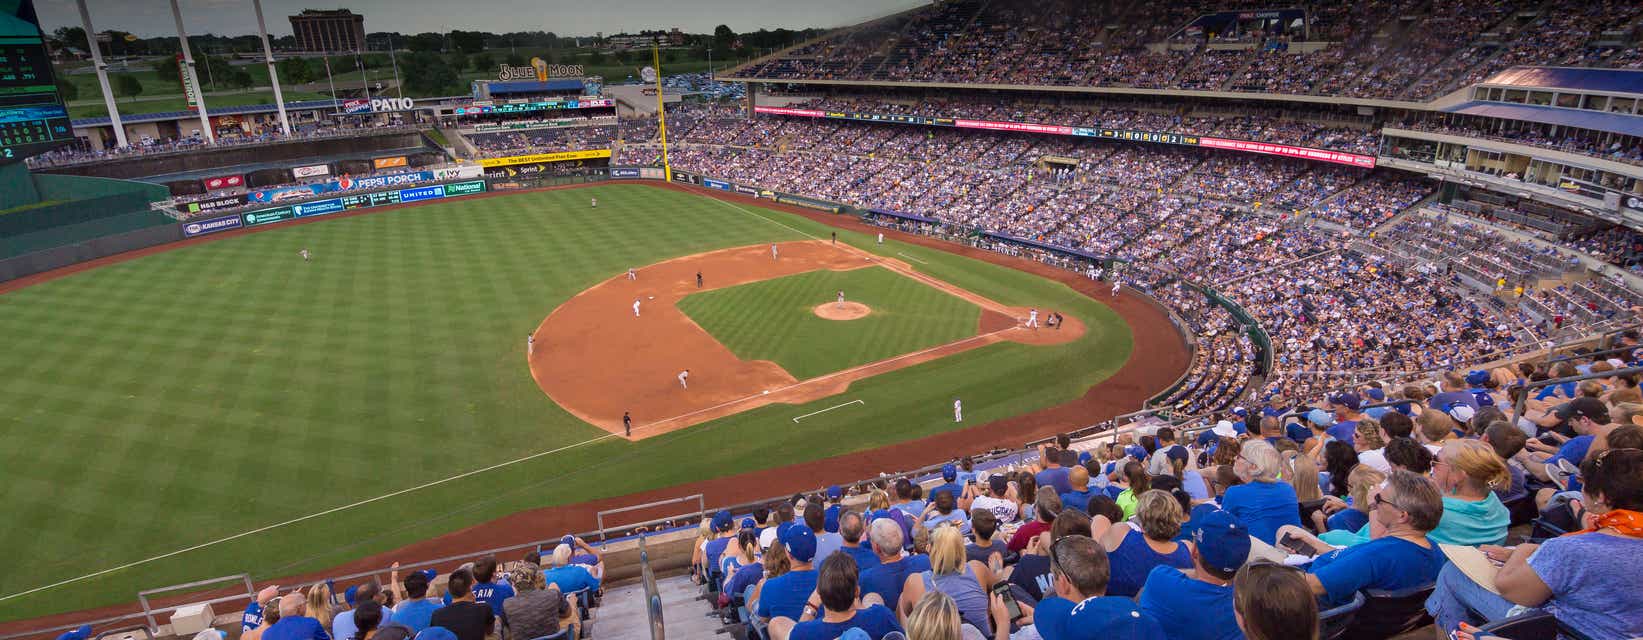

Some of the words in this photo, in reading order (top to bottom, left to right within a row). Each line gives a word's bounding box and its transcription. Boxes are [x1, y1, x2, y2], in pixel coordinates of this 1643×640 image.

[499, 64, 535, 80] BLUE
[549, 64, 584, 77] MOON
[371, 97, 414, 112] PATIO
[4, 148, 14, 158] 2
[520, 165, 539, 174] Sprint
[358, 177, 386, 189] PEPSI
[387, 172, 421, 185] PORCH
[455, 183, 481, 192] National
[403, 191, 434, 199] UNITED
[216, 198, 240, 207] BLOCK
[226, 217, 239, 225] CITY
